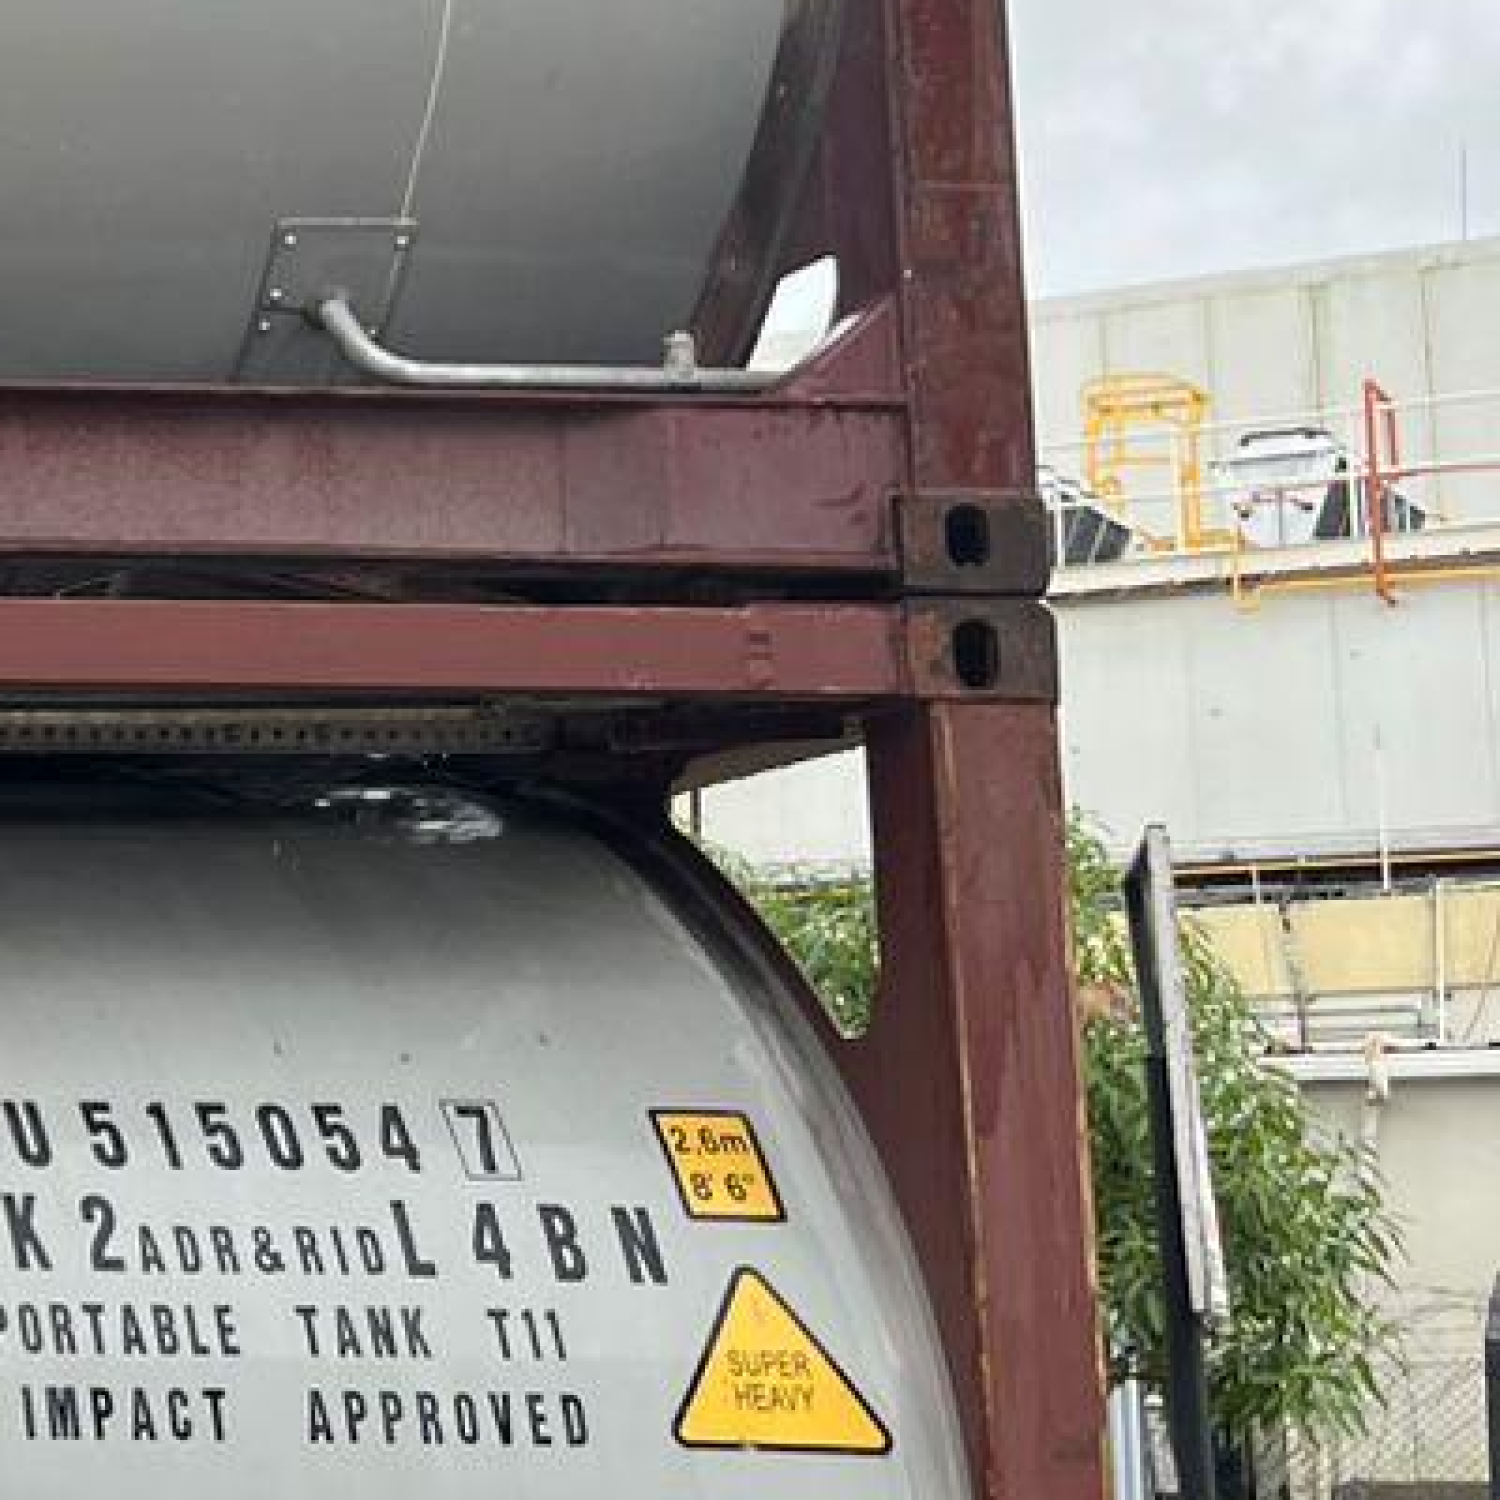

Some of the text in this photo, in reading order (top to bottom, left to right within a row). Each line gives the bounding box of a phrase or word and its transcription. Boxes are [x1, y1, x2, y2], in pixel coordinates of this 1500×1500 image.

[78, 1101, 421, 1174] 515054
[455, 1104, 498, 1175] 7
[138, 1225, 388, 1276] ADR&RID
[389, 1198, 669, 1285] L4BN
[292, 1305, 432, 1359] TANK
[486, 1308, 567, 1362] T11
[726, 1349, 812, 1378] SUPER
[19, 1386, 226, 1441] IMPACT
[307, 1390, 588, 1447] APPROVED
[733, 1383, 816, 1412] HEAVY
